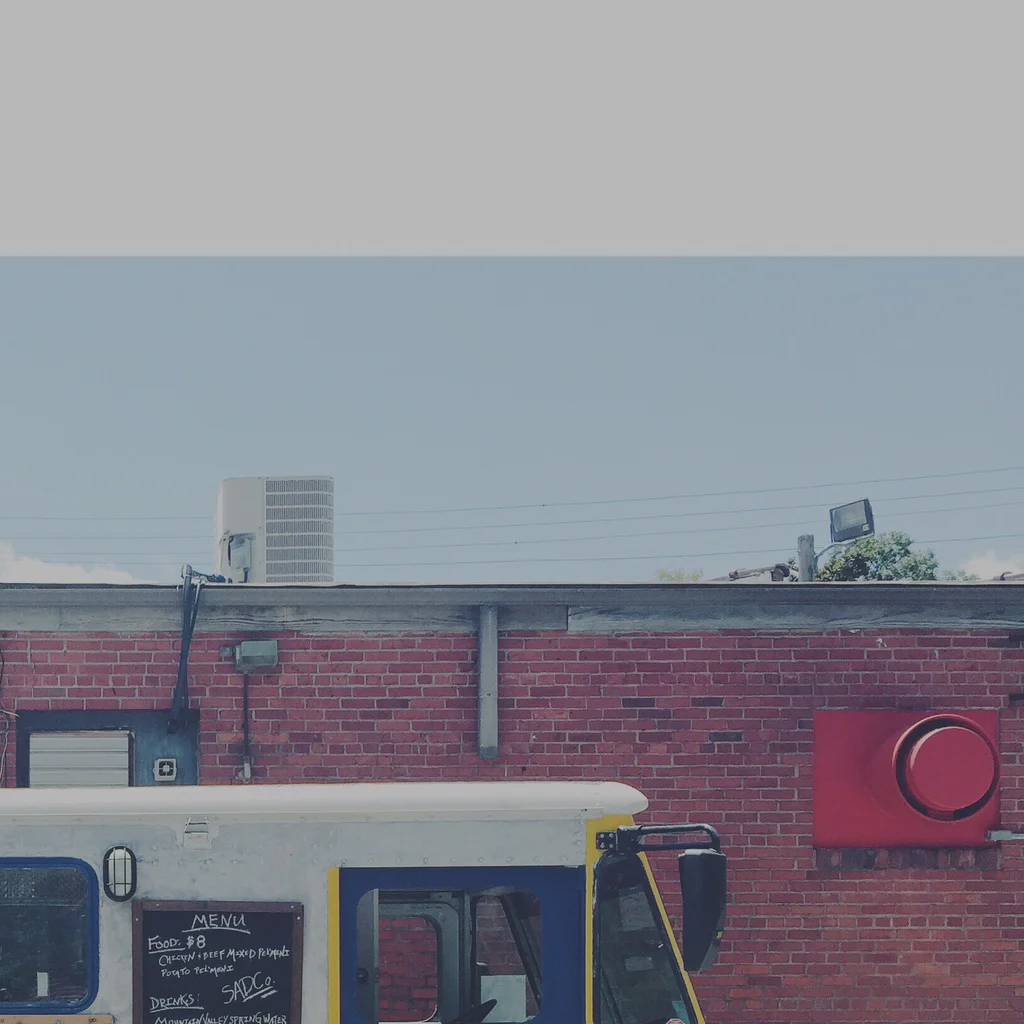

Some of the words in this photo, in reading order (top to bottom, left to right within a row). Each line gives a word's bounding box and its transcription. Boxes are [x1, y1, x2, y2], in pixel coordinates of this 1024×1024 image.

[191, 914, 246, 930] MENU
[203, 949, 226, 961] BEEF
[226, 948, 257, 962] MIXED
[160, 966, 191, 978] POTATO
